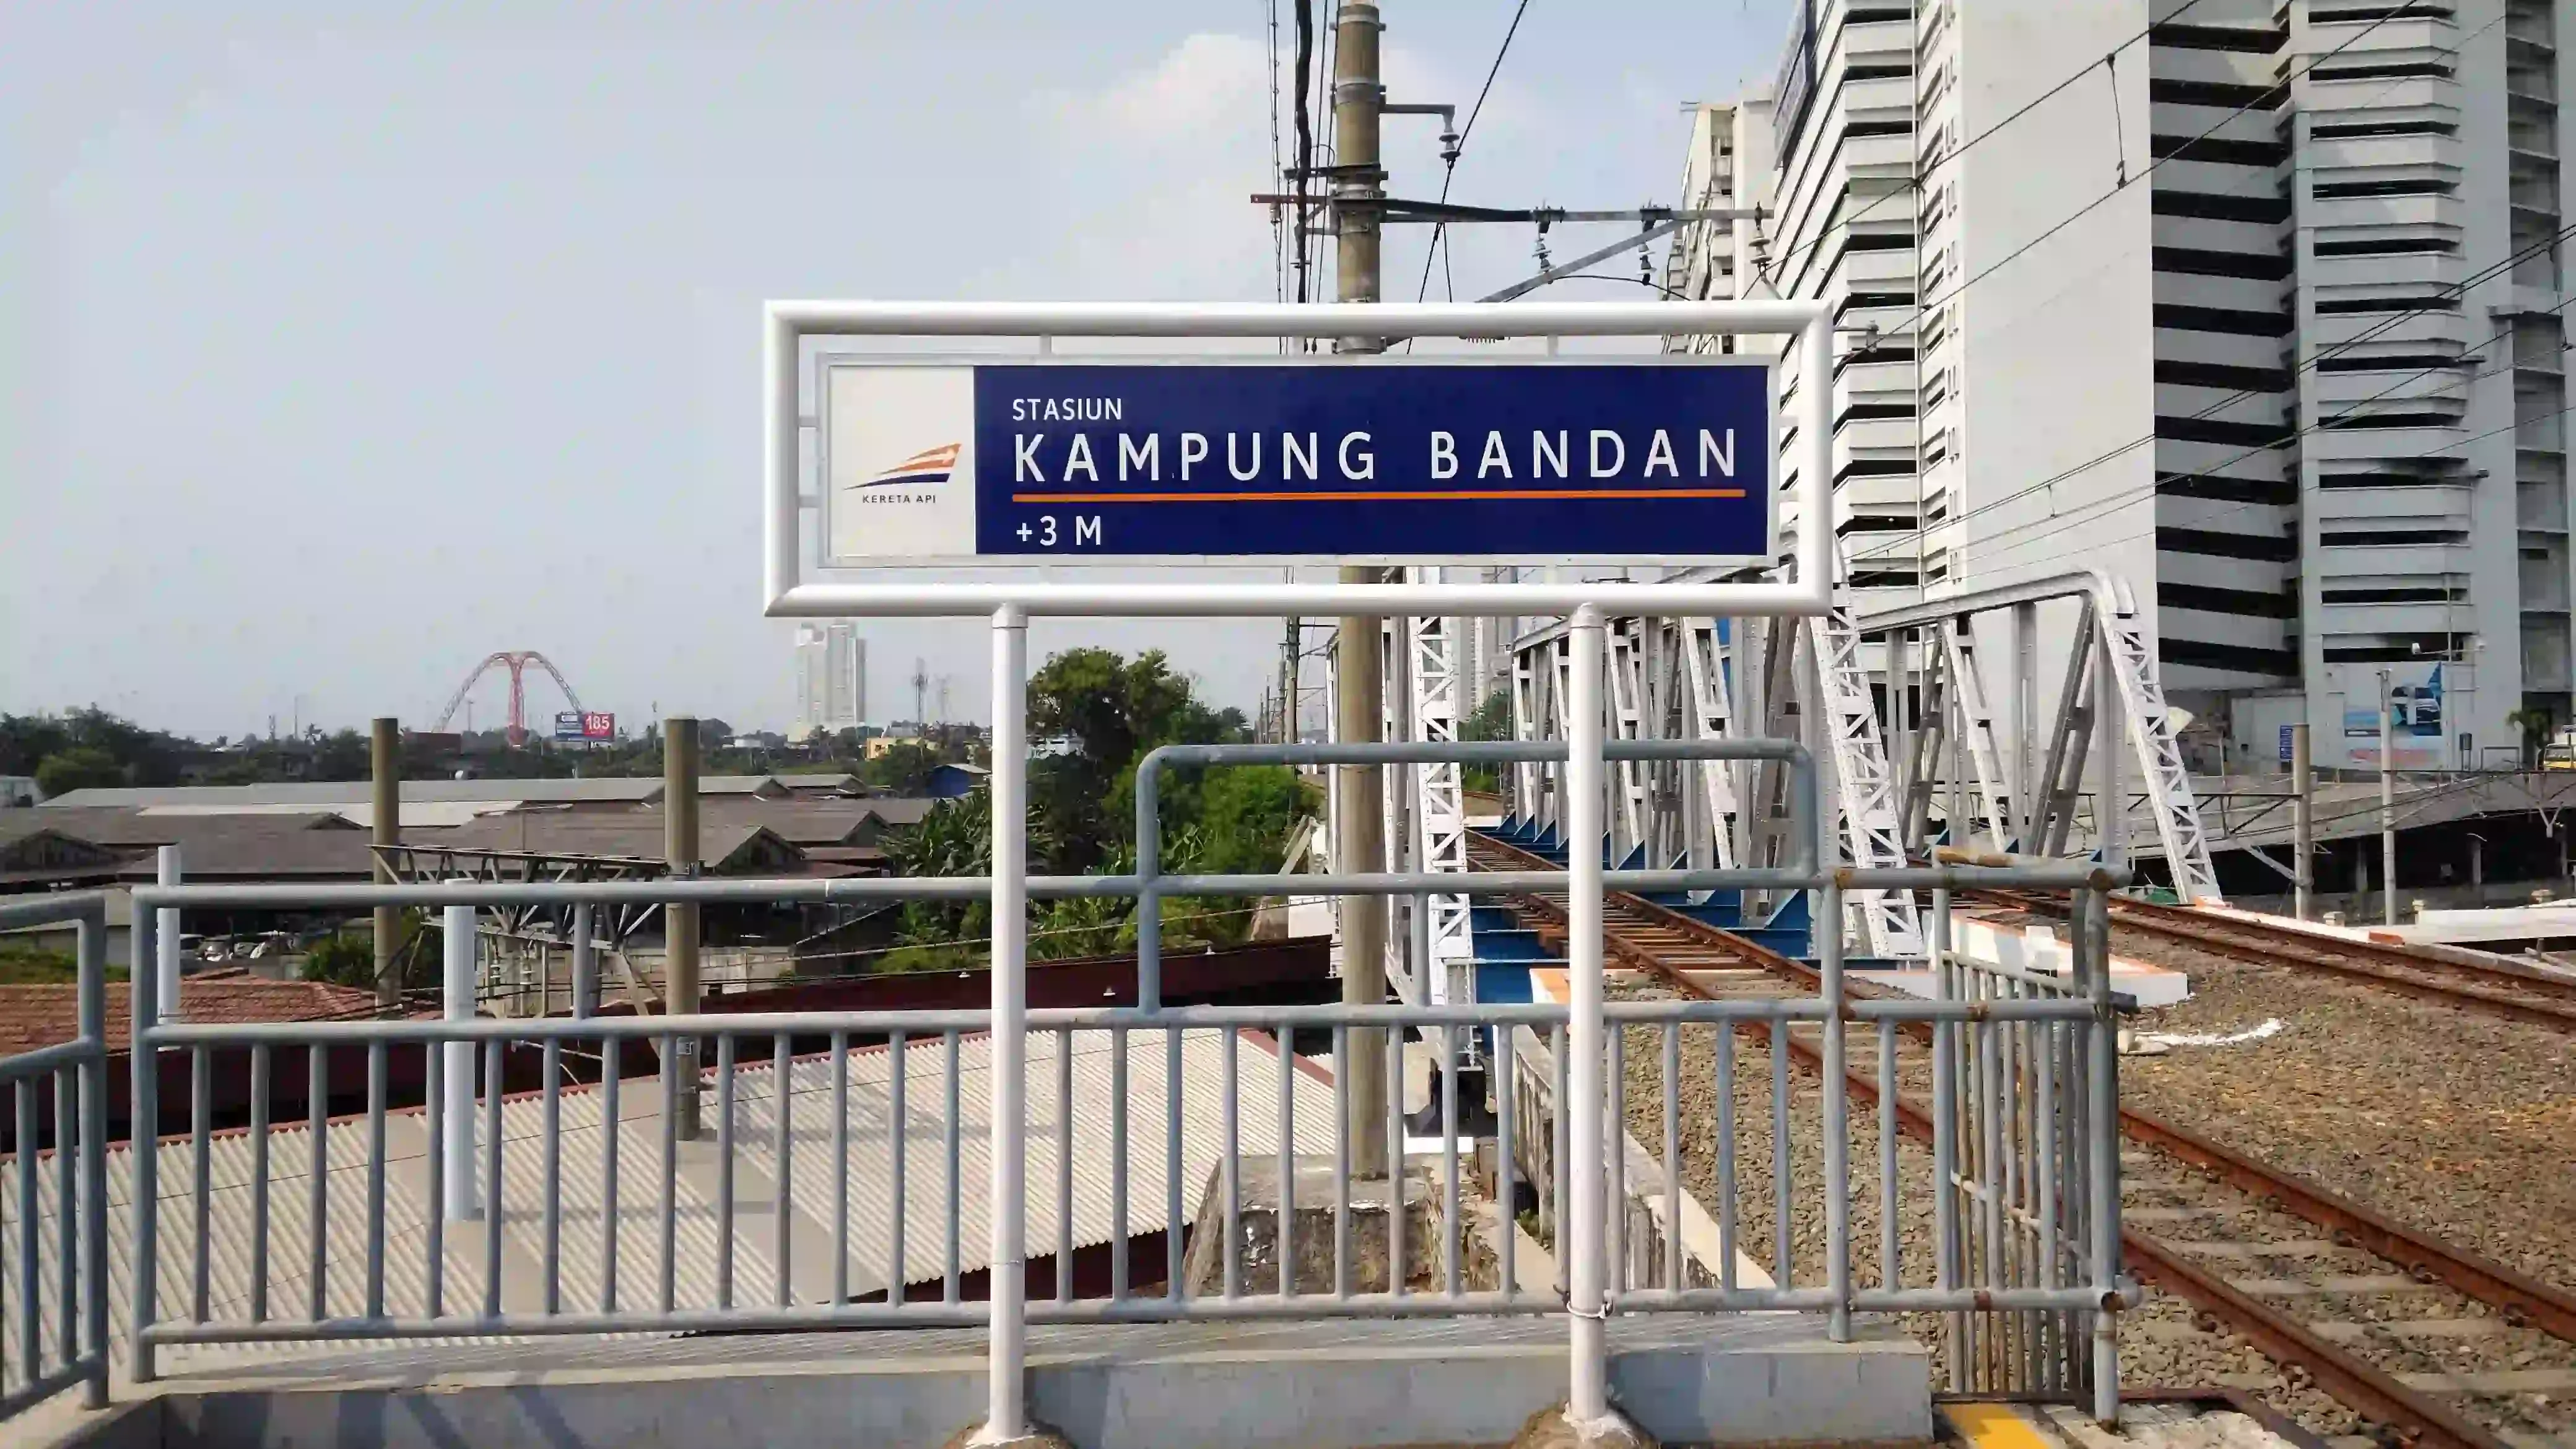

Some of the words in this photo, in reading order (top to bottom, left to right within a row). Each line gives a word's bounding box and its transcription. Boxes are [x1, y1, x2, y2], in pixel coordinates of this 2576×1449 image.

[1012, 398, 1122, 421] STASIUN
[1015, 432, 1375, 482] KAMPUNG
[1430, 429, 1734, 479] BANDAN
[863, 495, 910, 503] KERETA
[916, 495, 936, 503] API
[1016, 516, 1057, 546] +3
[1075, 516, 1101, 545] M
